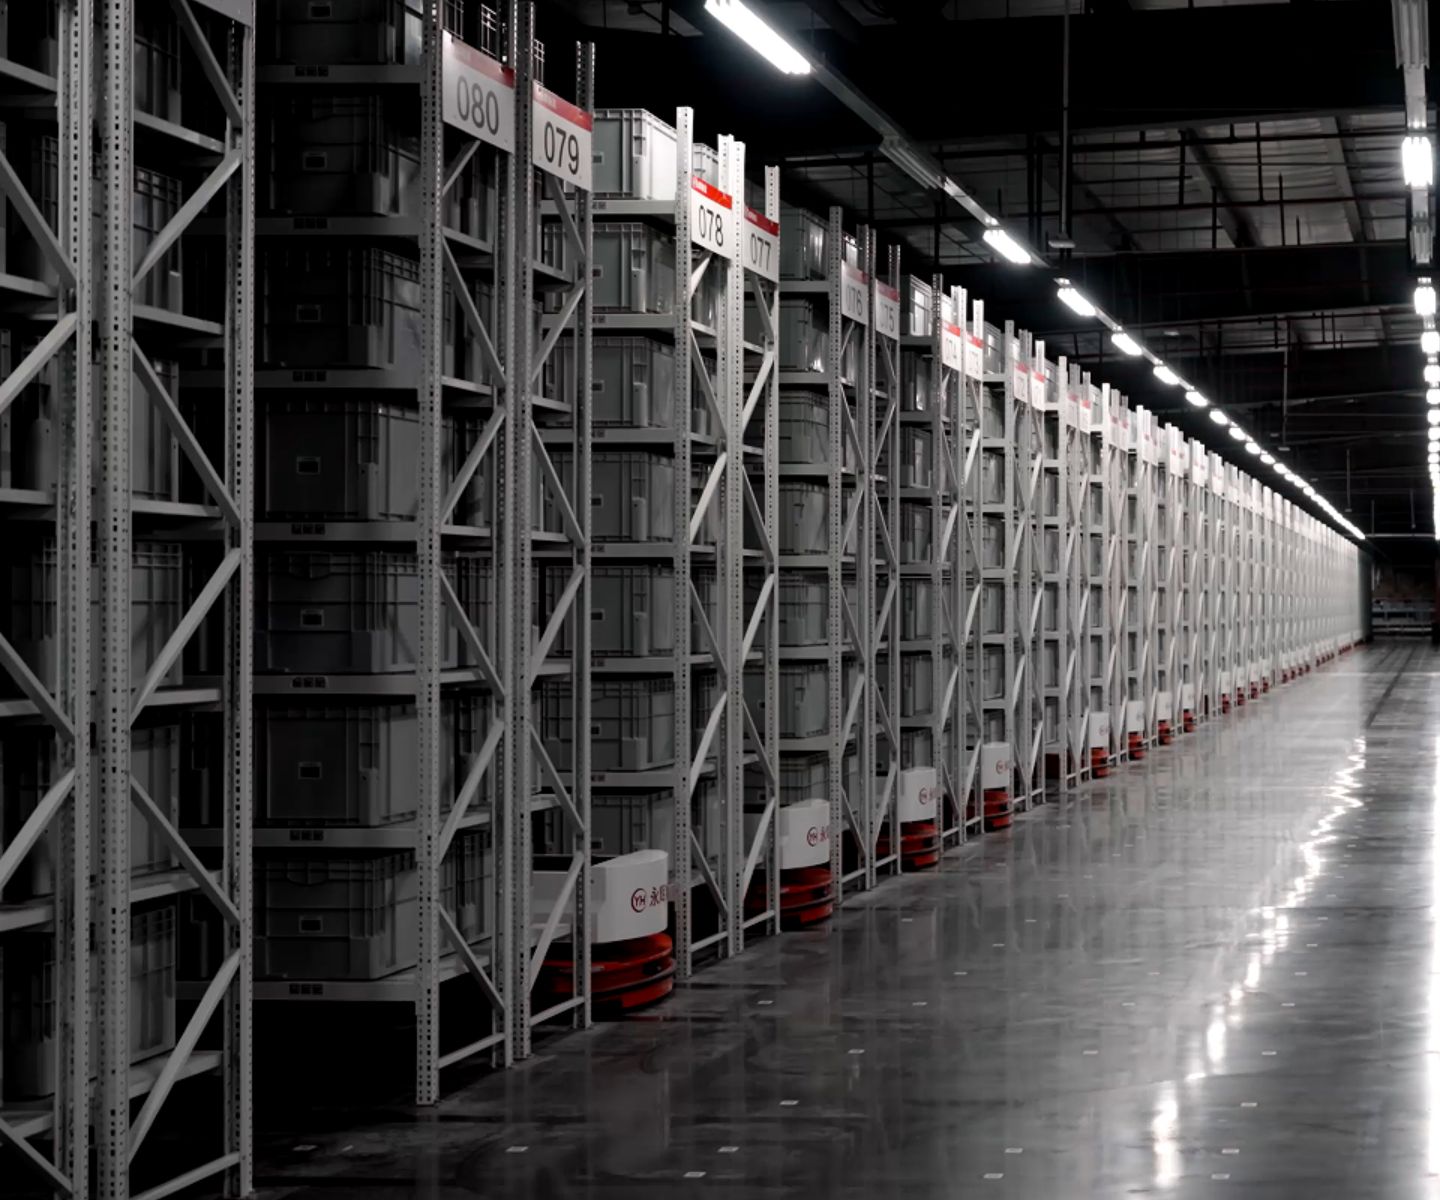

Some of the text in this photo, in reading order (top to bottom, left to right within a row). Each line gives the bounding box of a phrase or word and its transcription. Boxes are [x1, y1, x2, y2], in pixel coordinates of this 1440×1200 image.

[456, 75, 499, 136] 080
[544, 120, 580, 175] 079
[698, 204, 724, 247] 078
[751, 232, 771, 271] 077
[632, 892, 646, 909] YH
